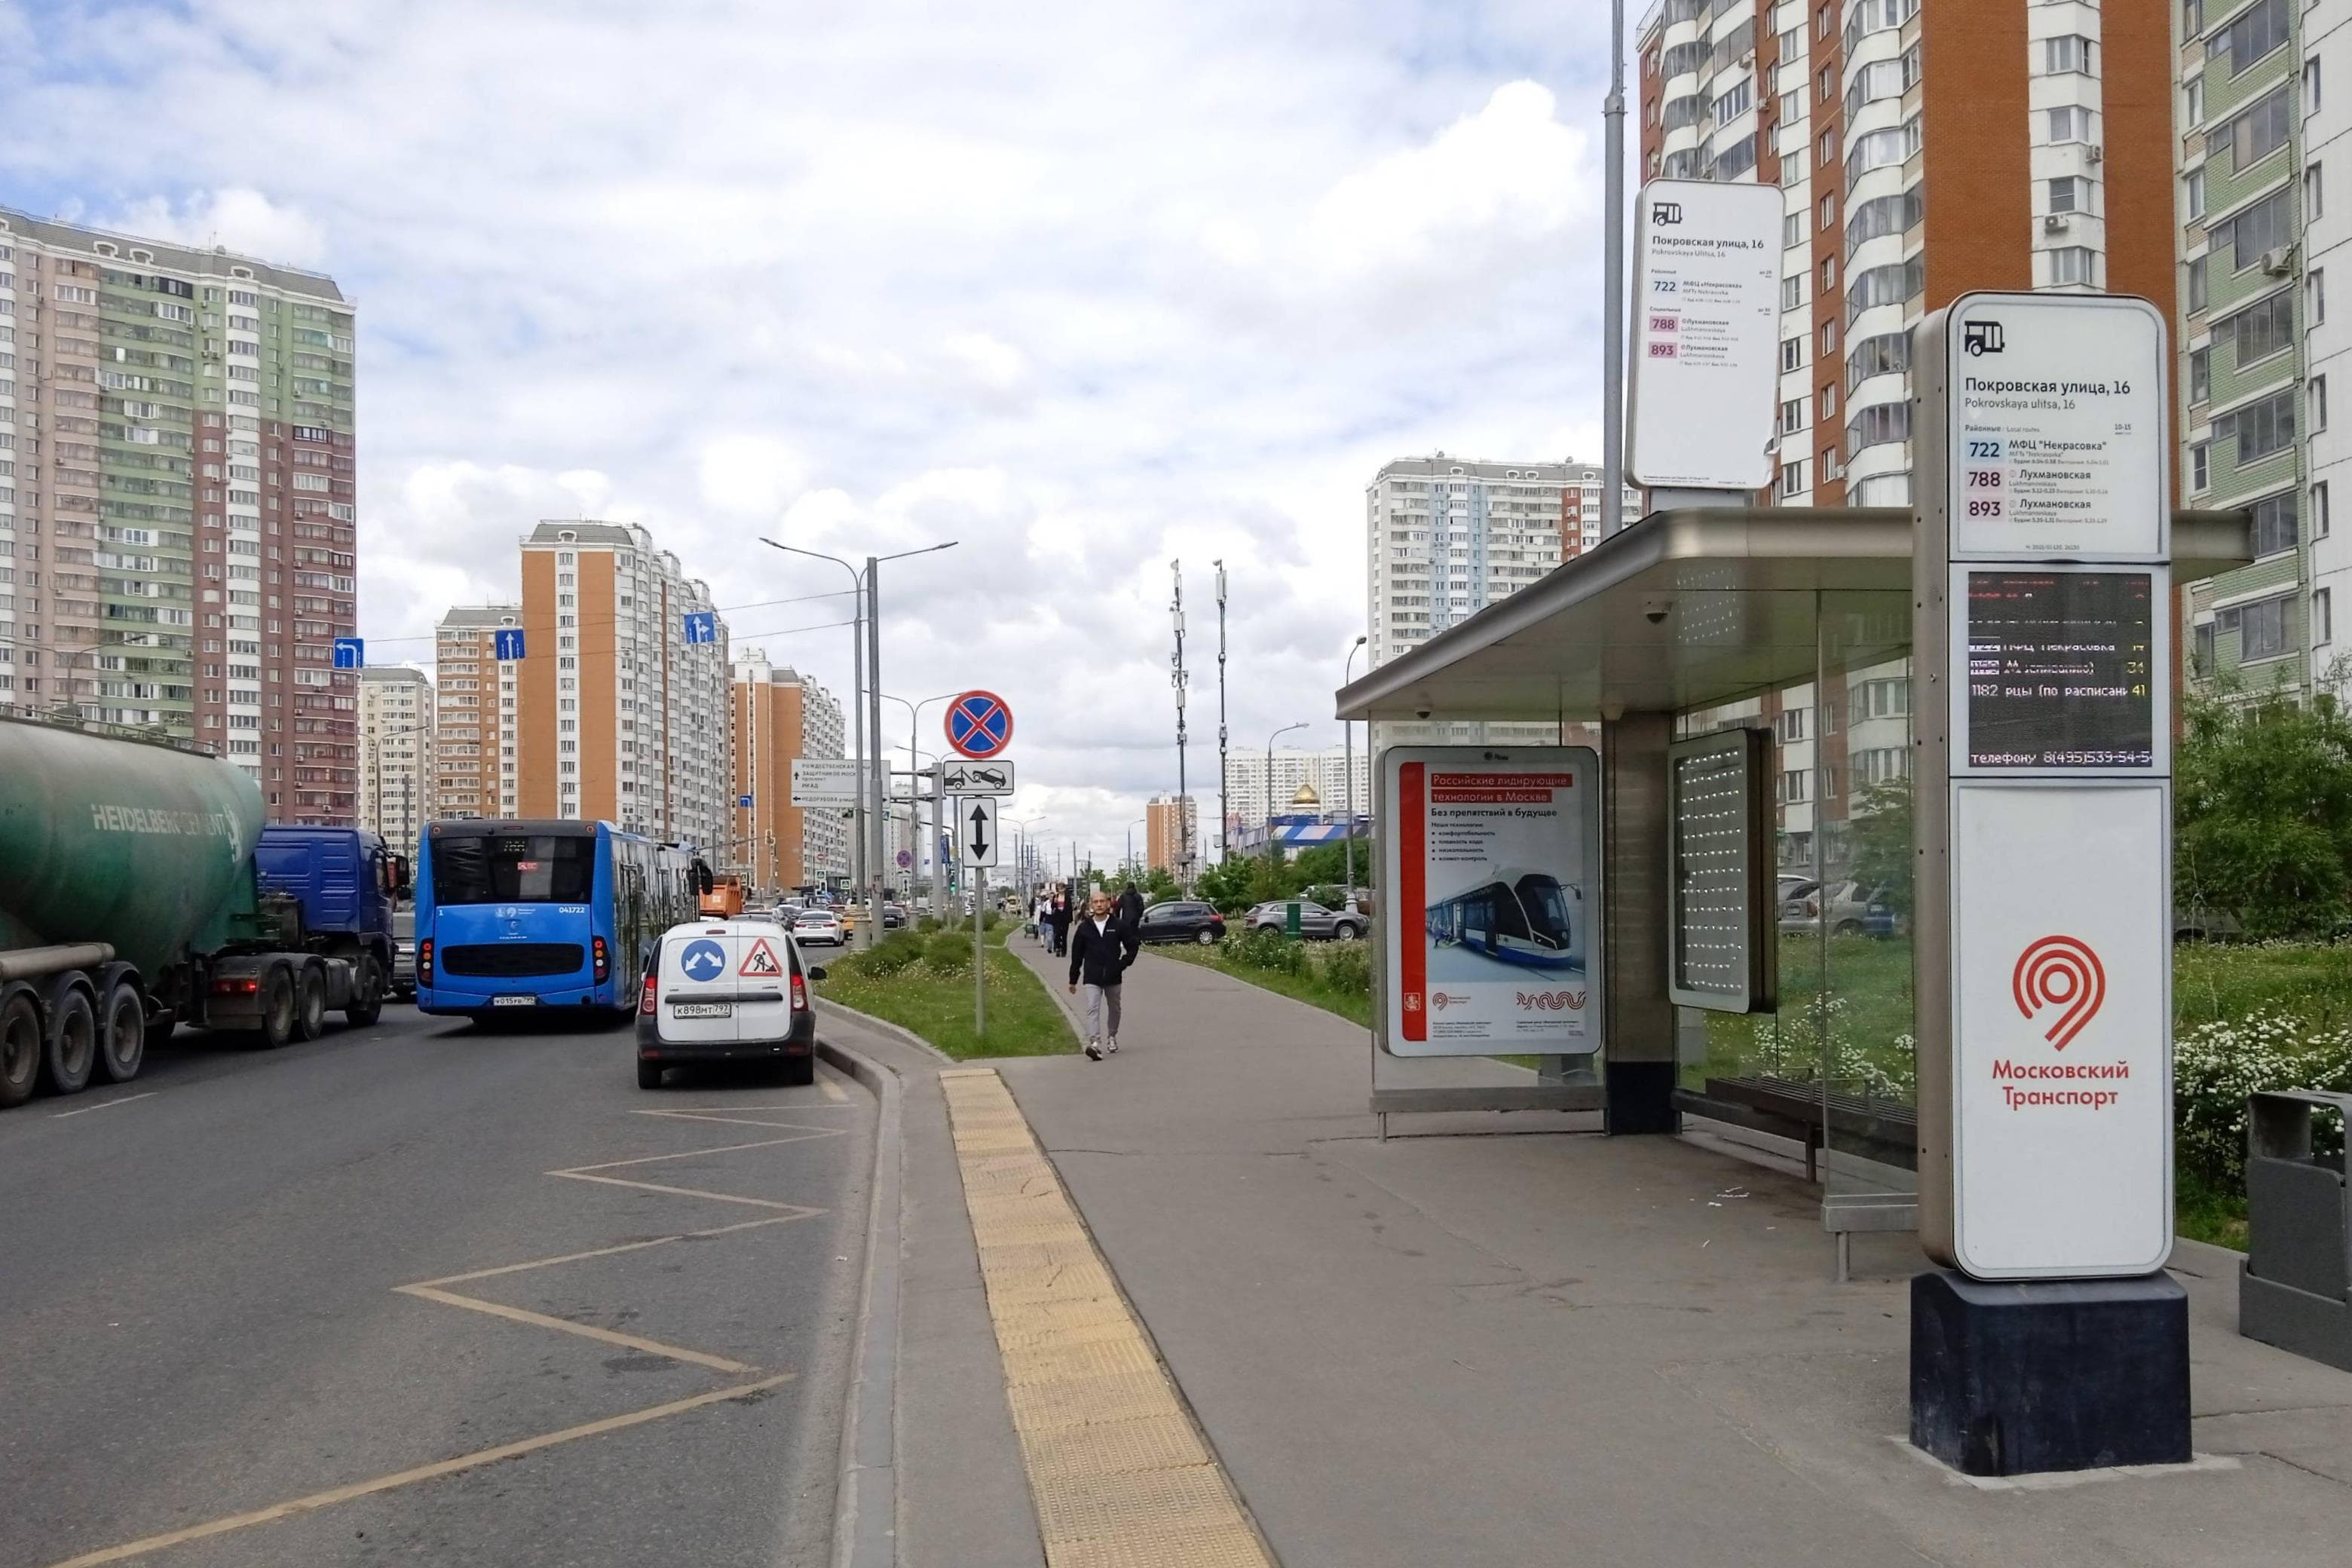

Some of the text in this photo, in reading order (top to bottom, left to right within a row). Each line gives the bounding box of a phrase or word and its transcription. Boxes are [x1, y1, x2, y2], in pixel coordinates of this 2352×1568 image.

[1652, 235, 1764, 250] Покровская улица, 16
[1651, 248, 1694, 258] Pokrovskaya
[1653, 280, 1677, 292] 722
[1652, 319, 1675, 329] 788
[1651, 345, 1674, 356] 893
[1965, 377, 2130, 397] Покровская улица, 16
[1965, 397, 2075, 410] Pokrovskaya ulitsa, 16
[1969, 442, 2000, 458] 722
[2008, 439, 2107, 452] МФЦ "Некрасовка"
[1968, 471, 2001, 487] 788
[2020, 469, 2091, 481] Лухмановская
[1968, 501, 2001, 516] 893
[2020, 498, 2092, 510] Лухмановская
[1971, 684, 1998, 697] 1182
[2005, 686, 2033, 698] рцы
[2038, 684, 2059, 697] (по
[2132, 684, 2145, 697] 41
[1971, 751, 2153, 766] телефону 8(495)539-54-5
[1433, 775, 1567, 788] Российские лидирующие
[1433, 793, 1493, 801] технологии
[1505, 792, 1548, 801] Москве
[91, 803, 227, 836] HEIDELBERENT
[1432, 807, 1447, 816] Без
[1450, 808, 1506, 819] препятствий
[1514, 807, 1557, 819] будущее
[677, 1005, 712, 1015] К898МТ
[1992, 1059, 2130, 1080] Московский
[2002, 1086, 2119, 1111] Транспорт
